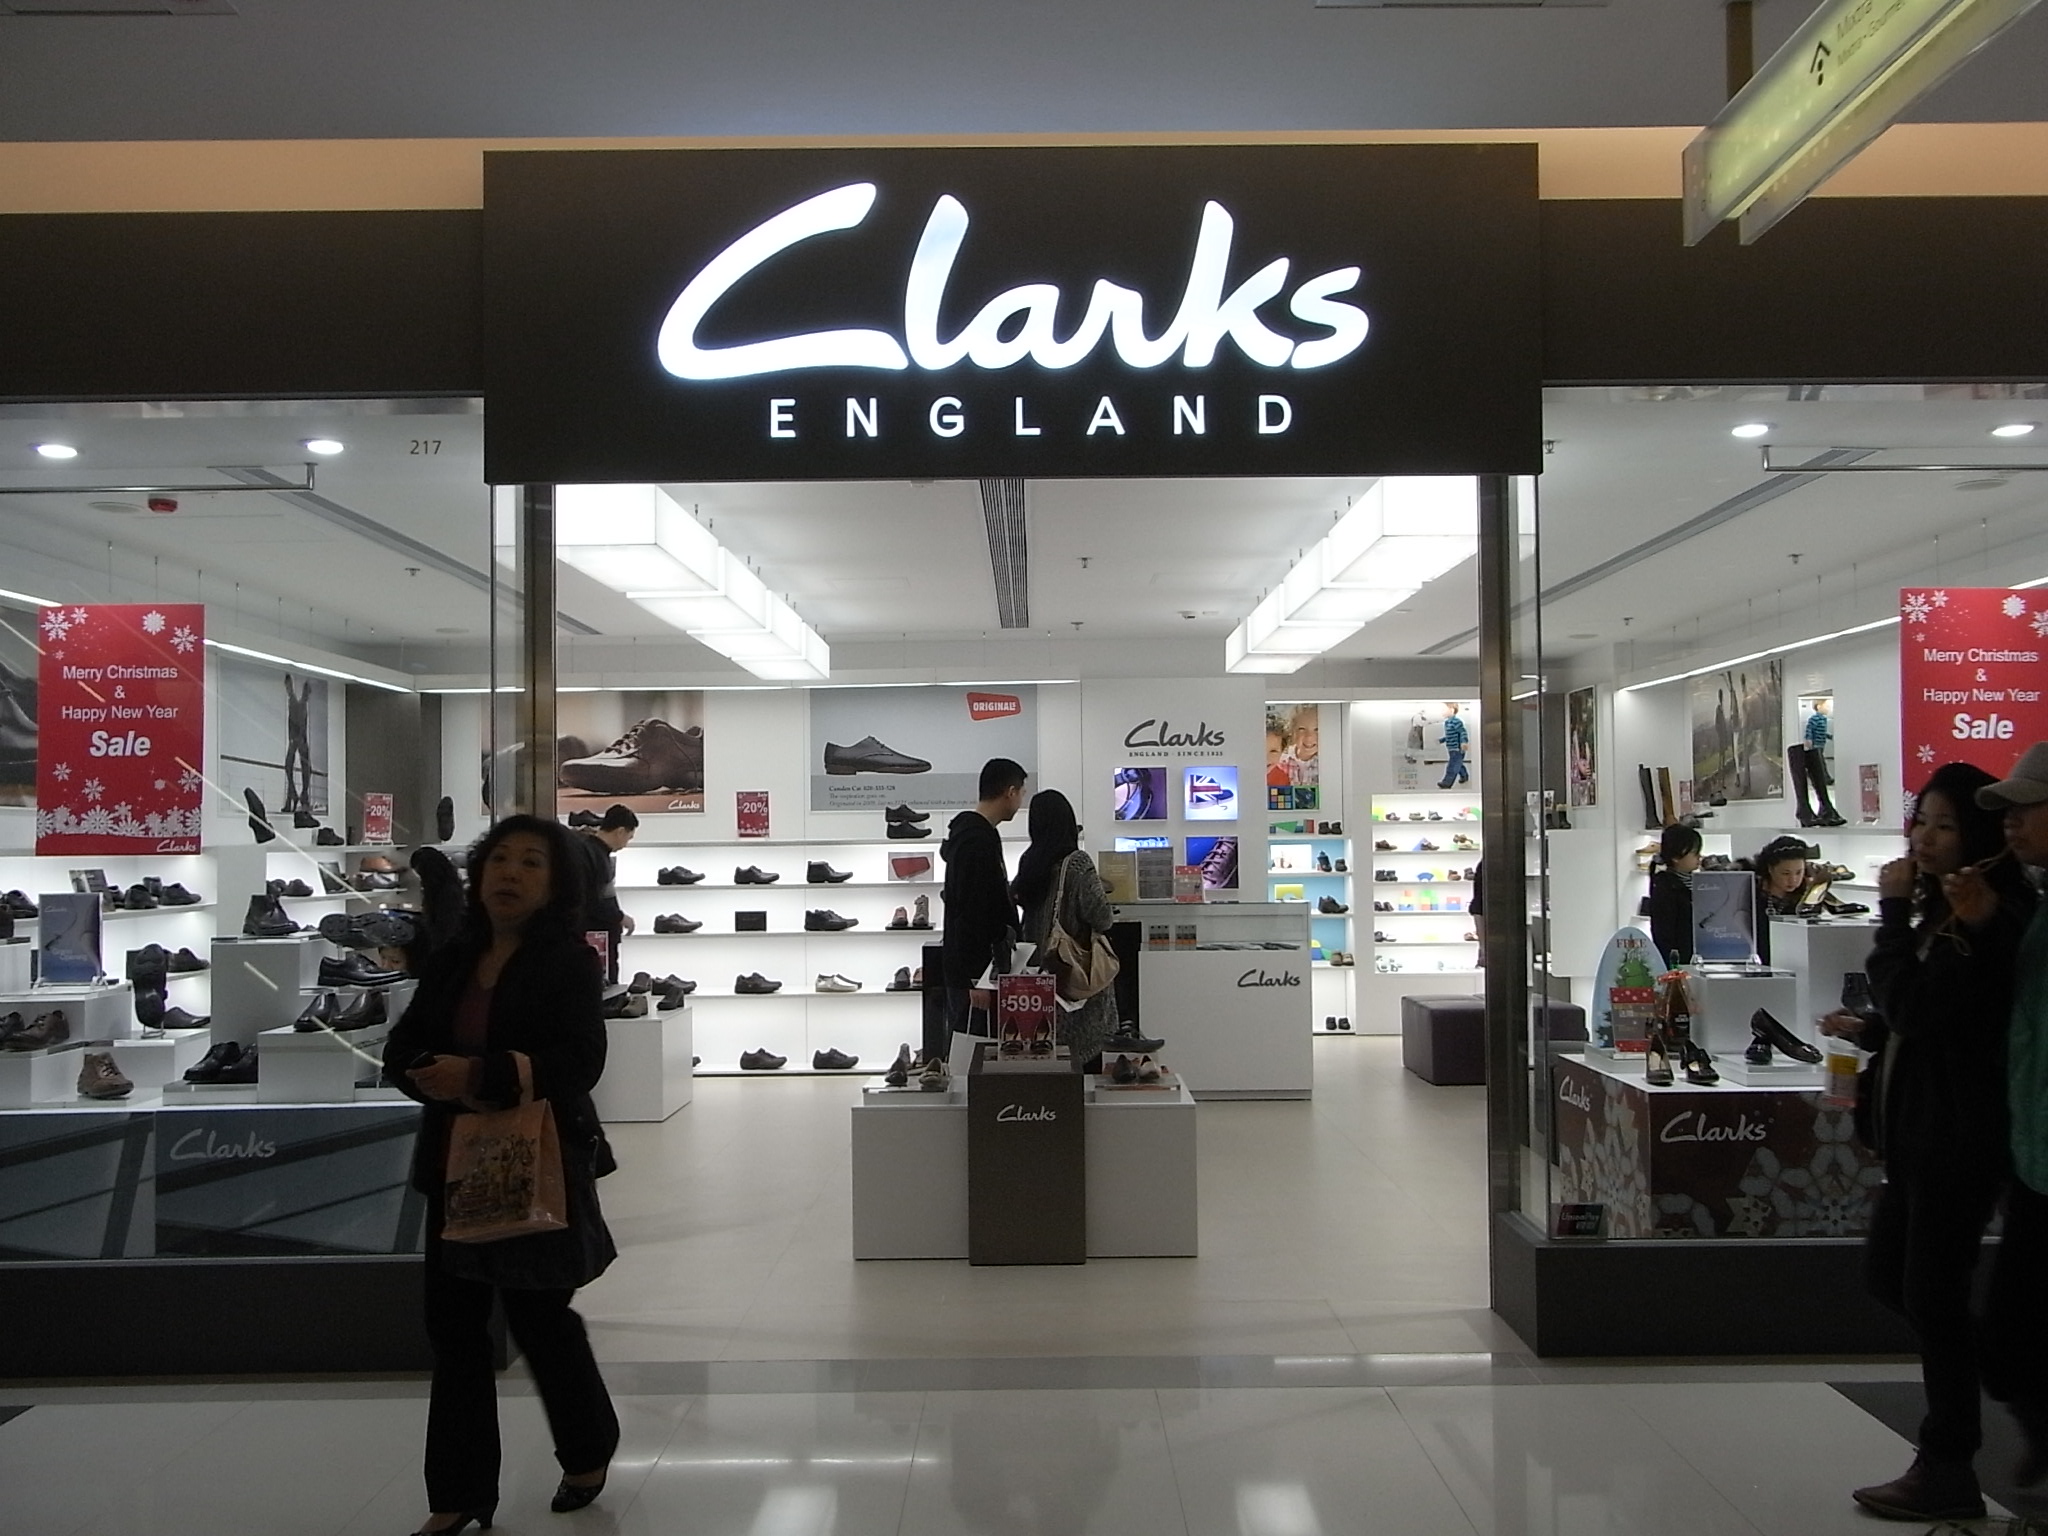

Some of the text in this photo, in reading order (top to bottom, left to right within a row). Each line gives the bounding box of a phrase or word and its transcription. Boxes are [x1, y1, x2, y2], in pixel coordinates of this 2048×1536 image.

[656, 182, 1369, 380] Clarks
[769, 394, 1293, 438] ENGLAND
[410, 440, 441, 454] 217
[1923, 648, 2039, 665] Merry Christmas
[62, 665, 178, 682] Merry Christmas
[1976, 668, 1987, 681] &
[114, 685, 125, 699] &
[1923, 688, 2040, 704] Happy New Year
[62, 705, 179, 722] Happy New Year
[1124, 719, 1225, 748] Clarks
[1952, 712, 2015, 739] Sale
[89, 730, 151, 757] Sale
[668, 799, 700, 810] Clarks
[156, 839, 197, 852] Clarks
[1036, 977, 1054, 985] Sale
[1237, 968, 1301, 988] Clarks
[1559, 1075, 1591, 1112] Clarks
[997, 1104, 1057, 1122] Clarks
[1660, 1110, 1767, 1143] Clarks
[169, 1128, 277, 1160] Clarks
